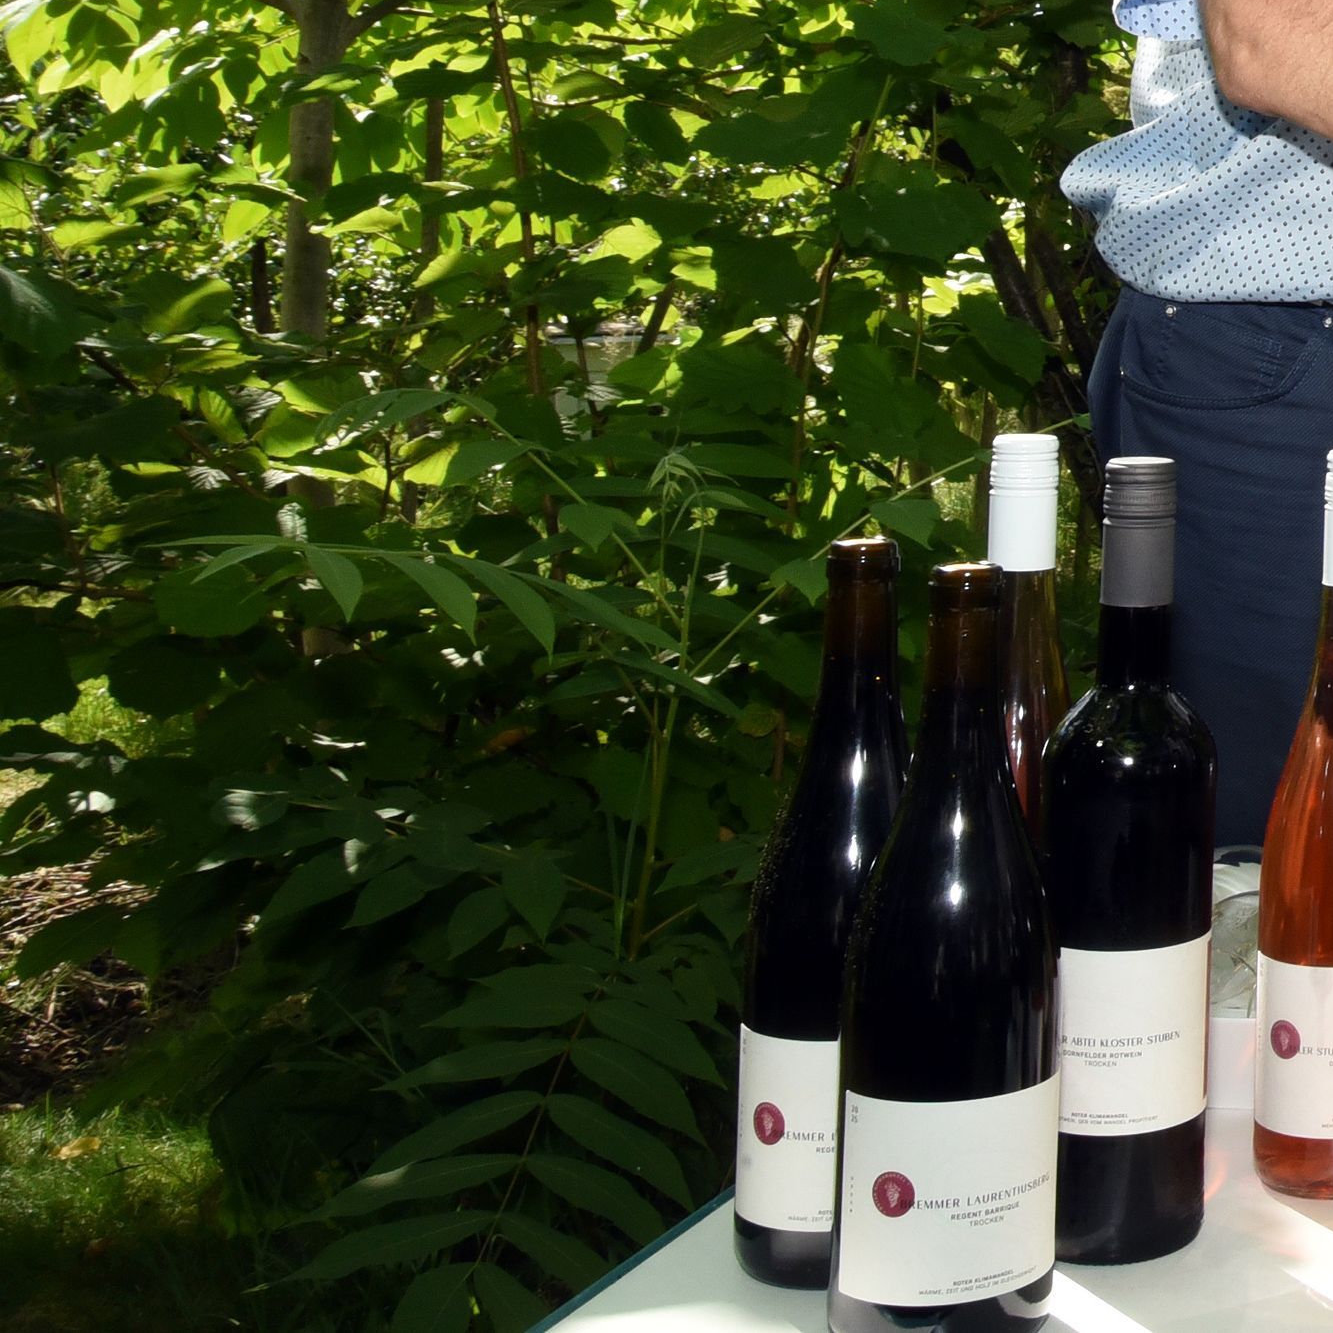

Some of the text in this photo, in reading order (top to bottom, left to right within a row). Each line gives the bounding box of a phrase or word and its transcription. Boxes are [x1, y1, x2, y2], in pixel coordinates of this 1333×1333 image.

[1071, 1036, 1096, 1047] ABTEI
[1100, 1037, 1143, 1047] KLOSTER
[1147, 1030, 1181, 1045] STUBEN
[1063, 1050, 1143, 1059] DORNFELDER ROTWEIN
[899, 1172, 1050, 1210] BREMMER LAURENTIUSBERG
[950, 1202, 1020, 1221] REGENT BARRIQUE
[970, 1216, 1005, 1227] TROCKEN
